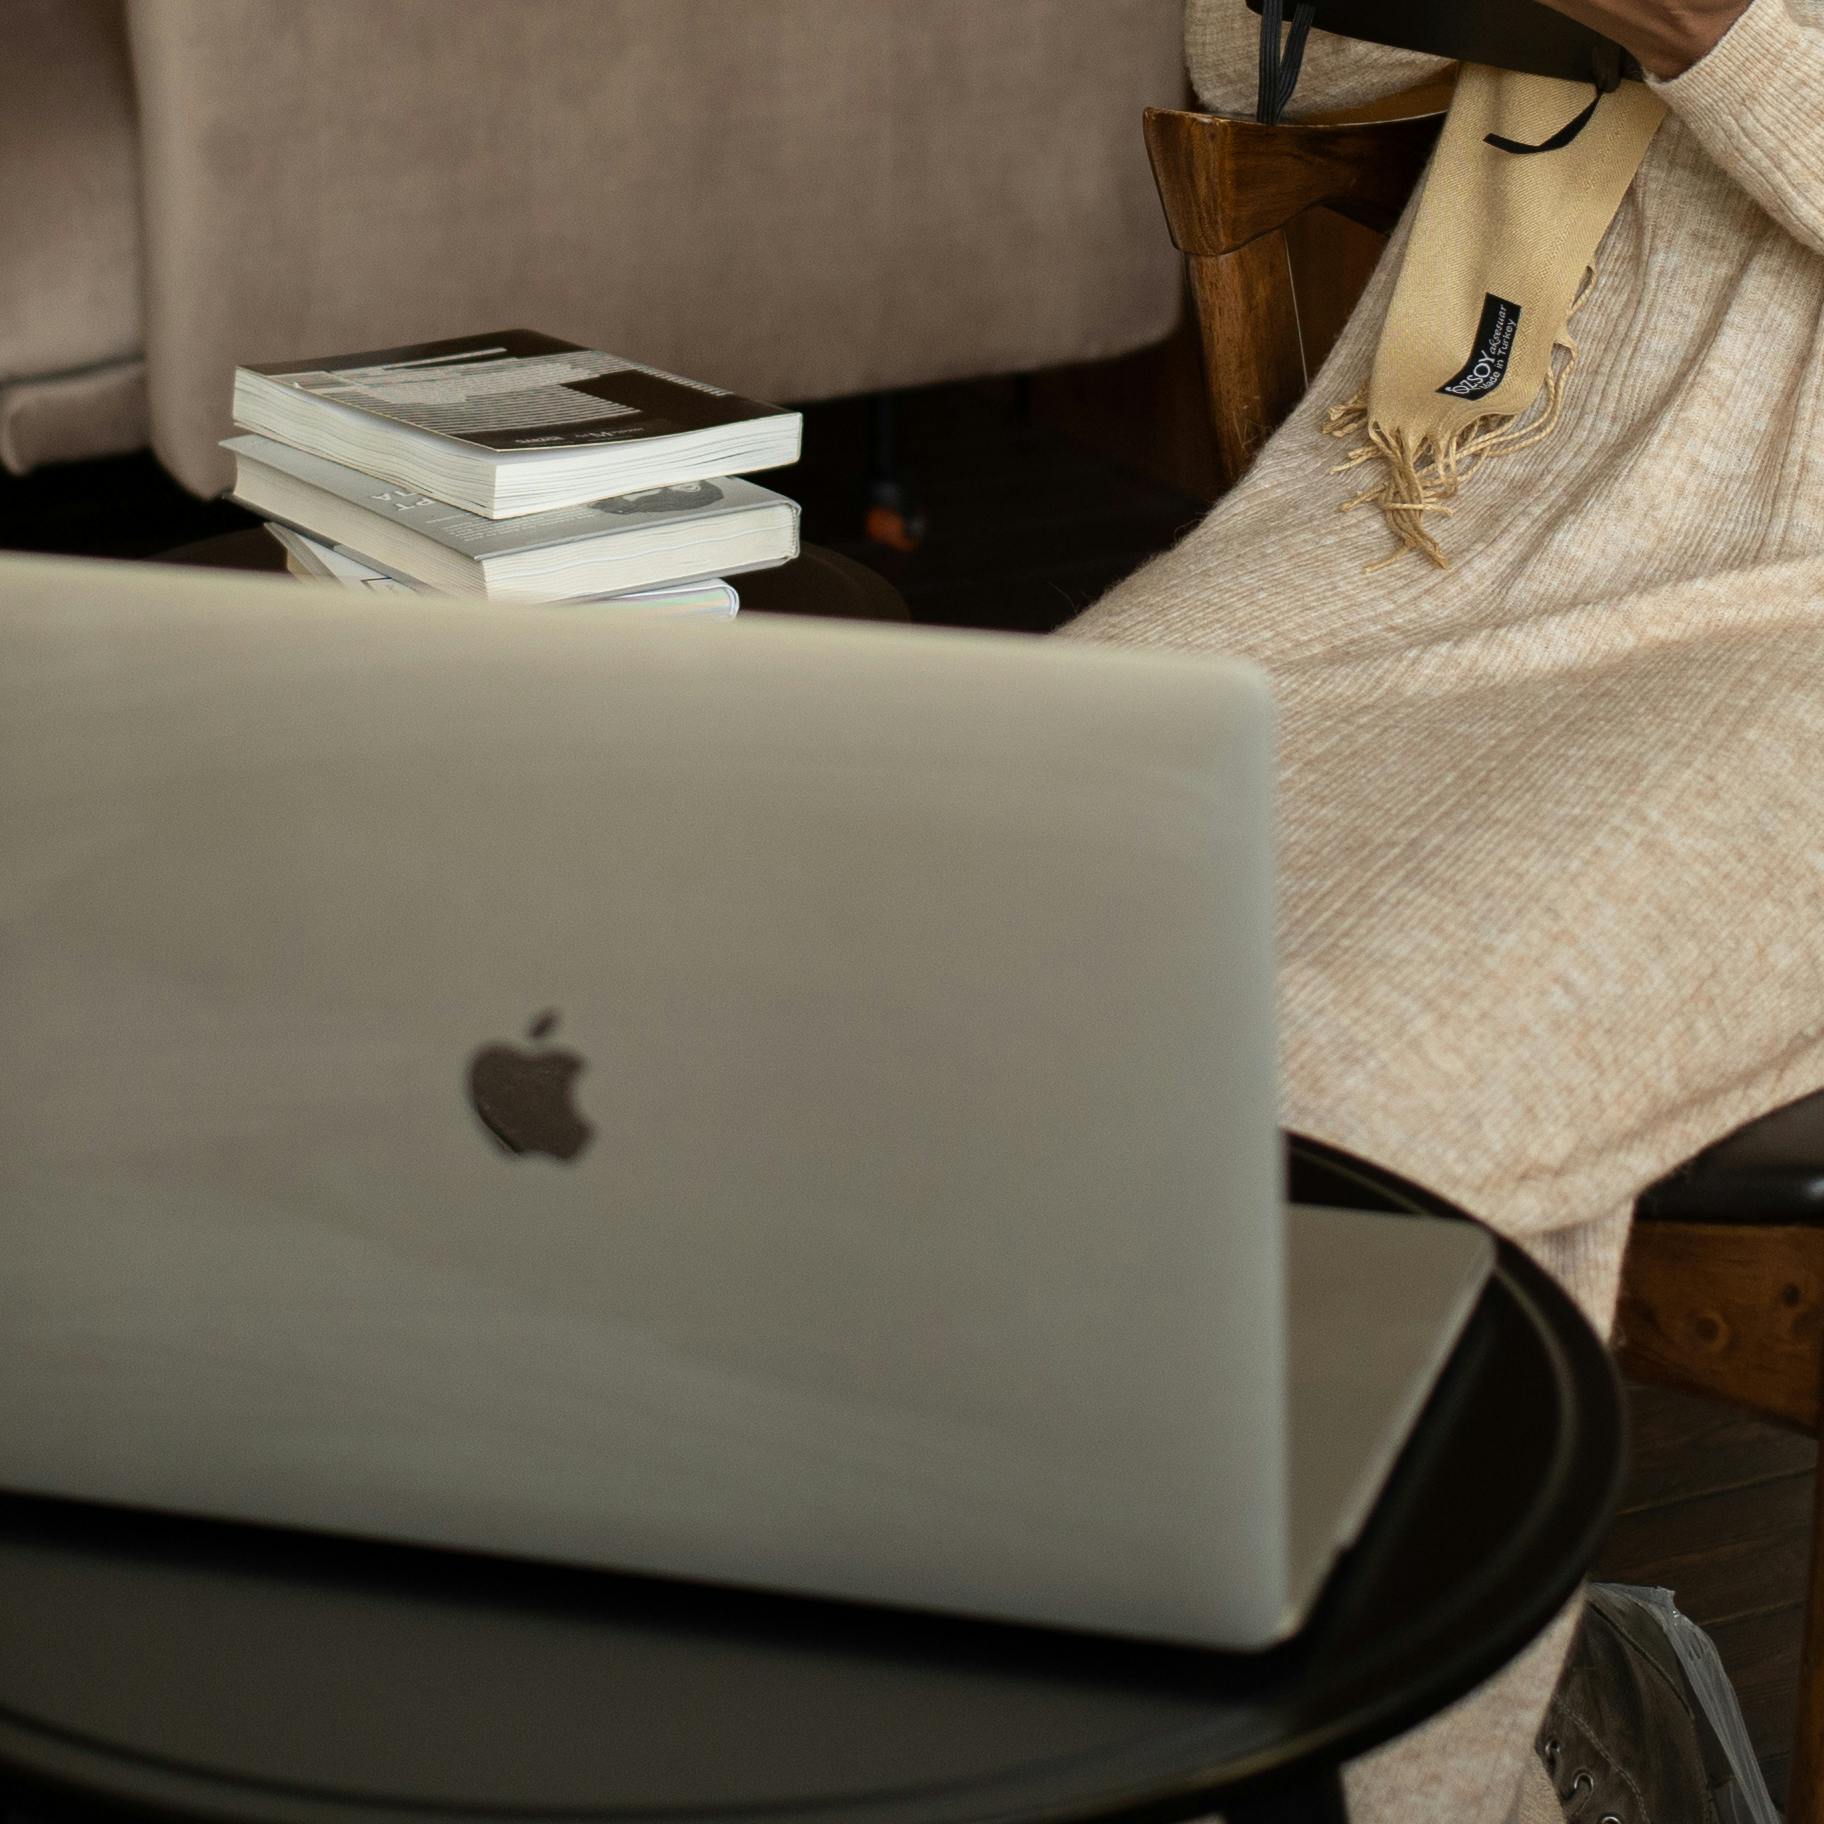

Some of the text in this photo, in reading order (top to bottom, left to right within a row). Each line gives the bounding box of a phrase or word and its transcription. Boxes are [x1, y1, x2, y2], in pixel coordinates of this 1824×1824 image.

[1481, 318, 1517, 389] Made in Turkey
[1488, 304, 1508, 355] aksesuar
